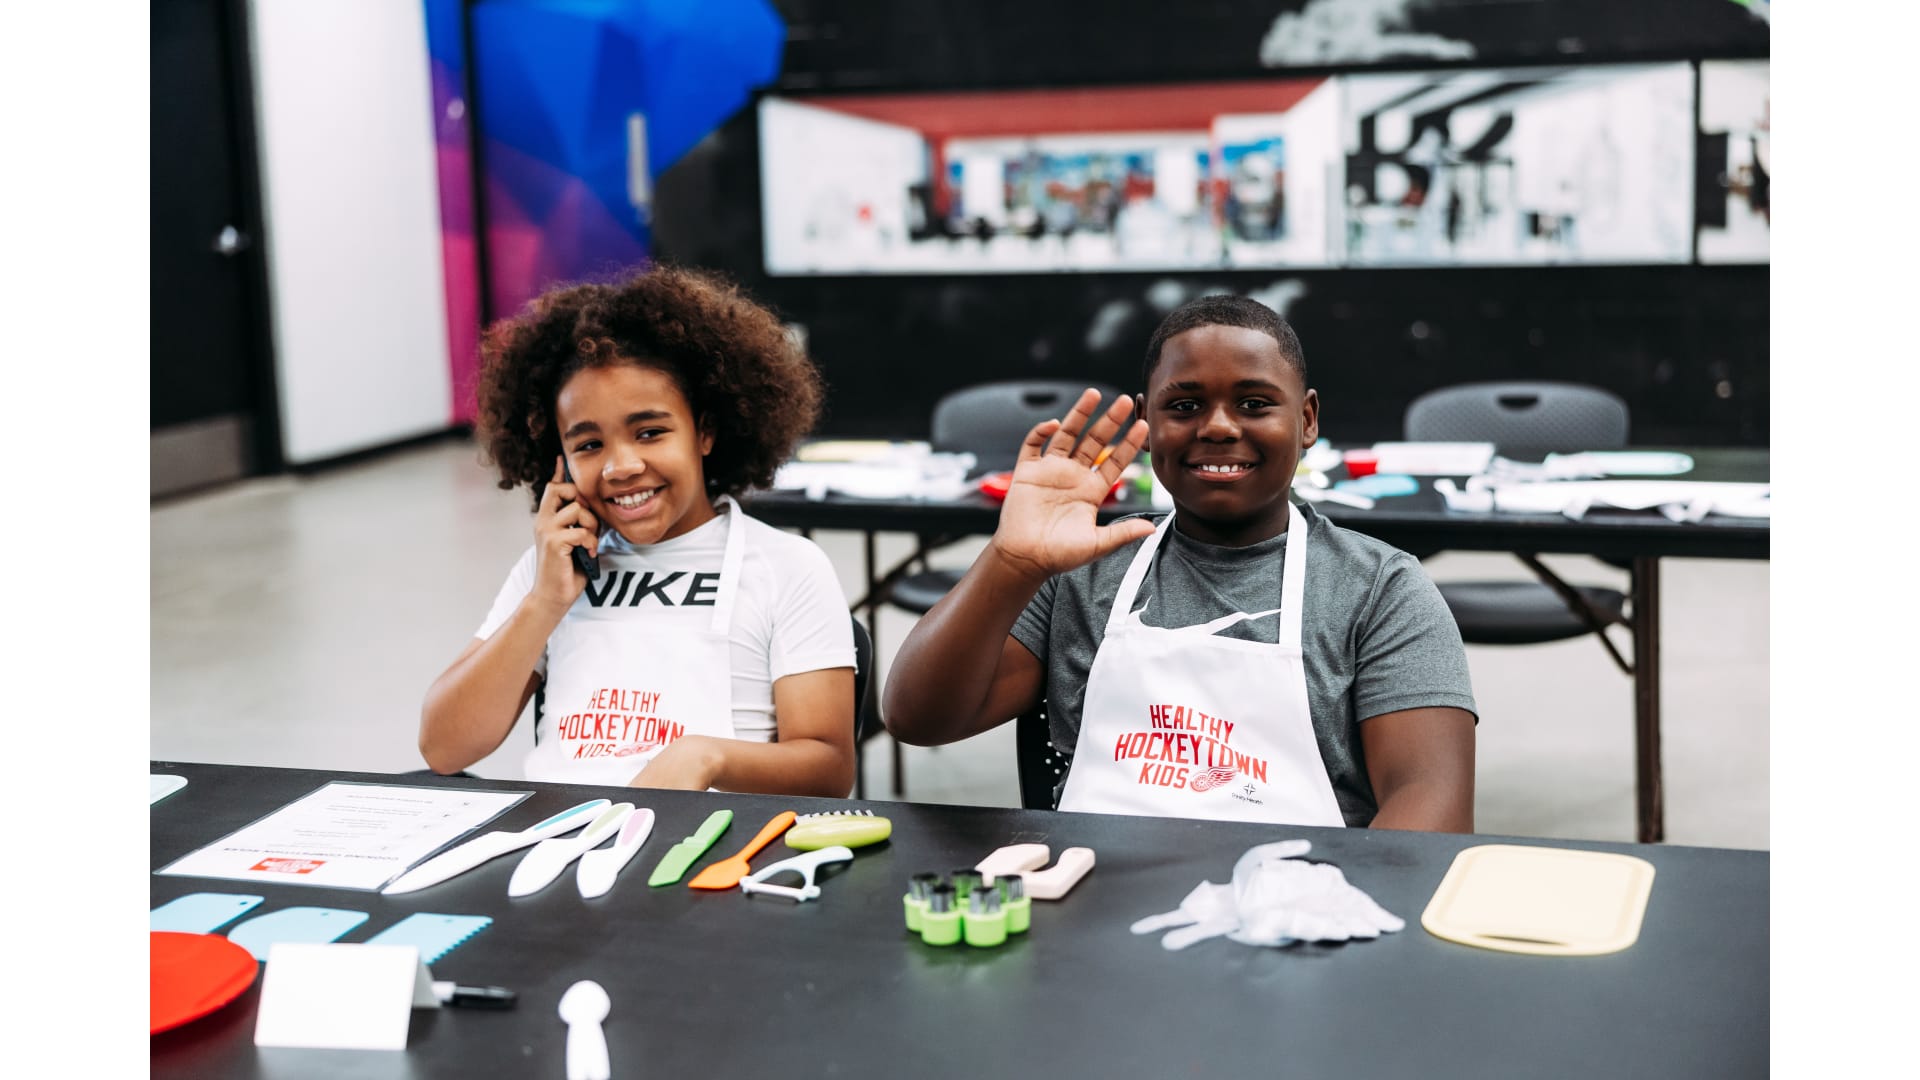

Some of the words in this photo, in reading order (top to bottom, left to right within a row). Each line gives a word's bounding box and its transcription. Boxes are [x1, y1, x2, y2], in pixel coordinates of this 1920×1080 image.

[588, 689, 662, 713] HEALTHY
[559, 713, 685, 746] HOCKEYTOWN
[1149, 704, 1234, 744] HEALTHY
[573, 743, 616, 759] KIDS
[1114, 732, 1268, 784] HOCKEYTOWN
[1138, 762, 1190, 789] KIDS
